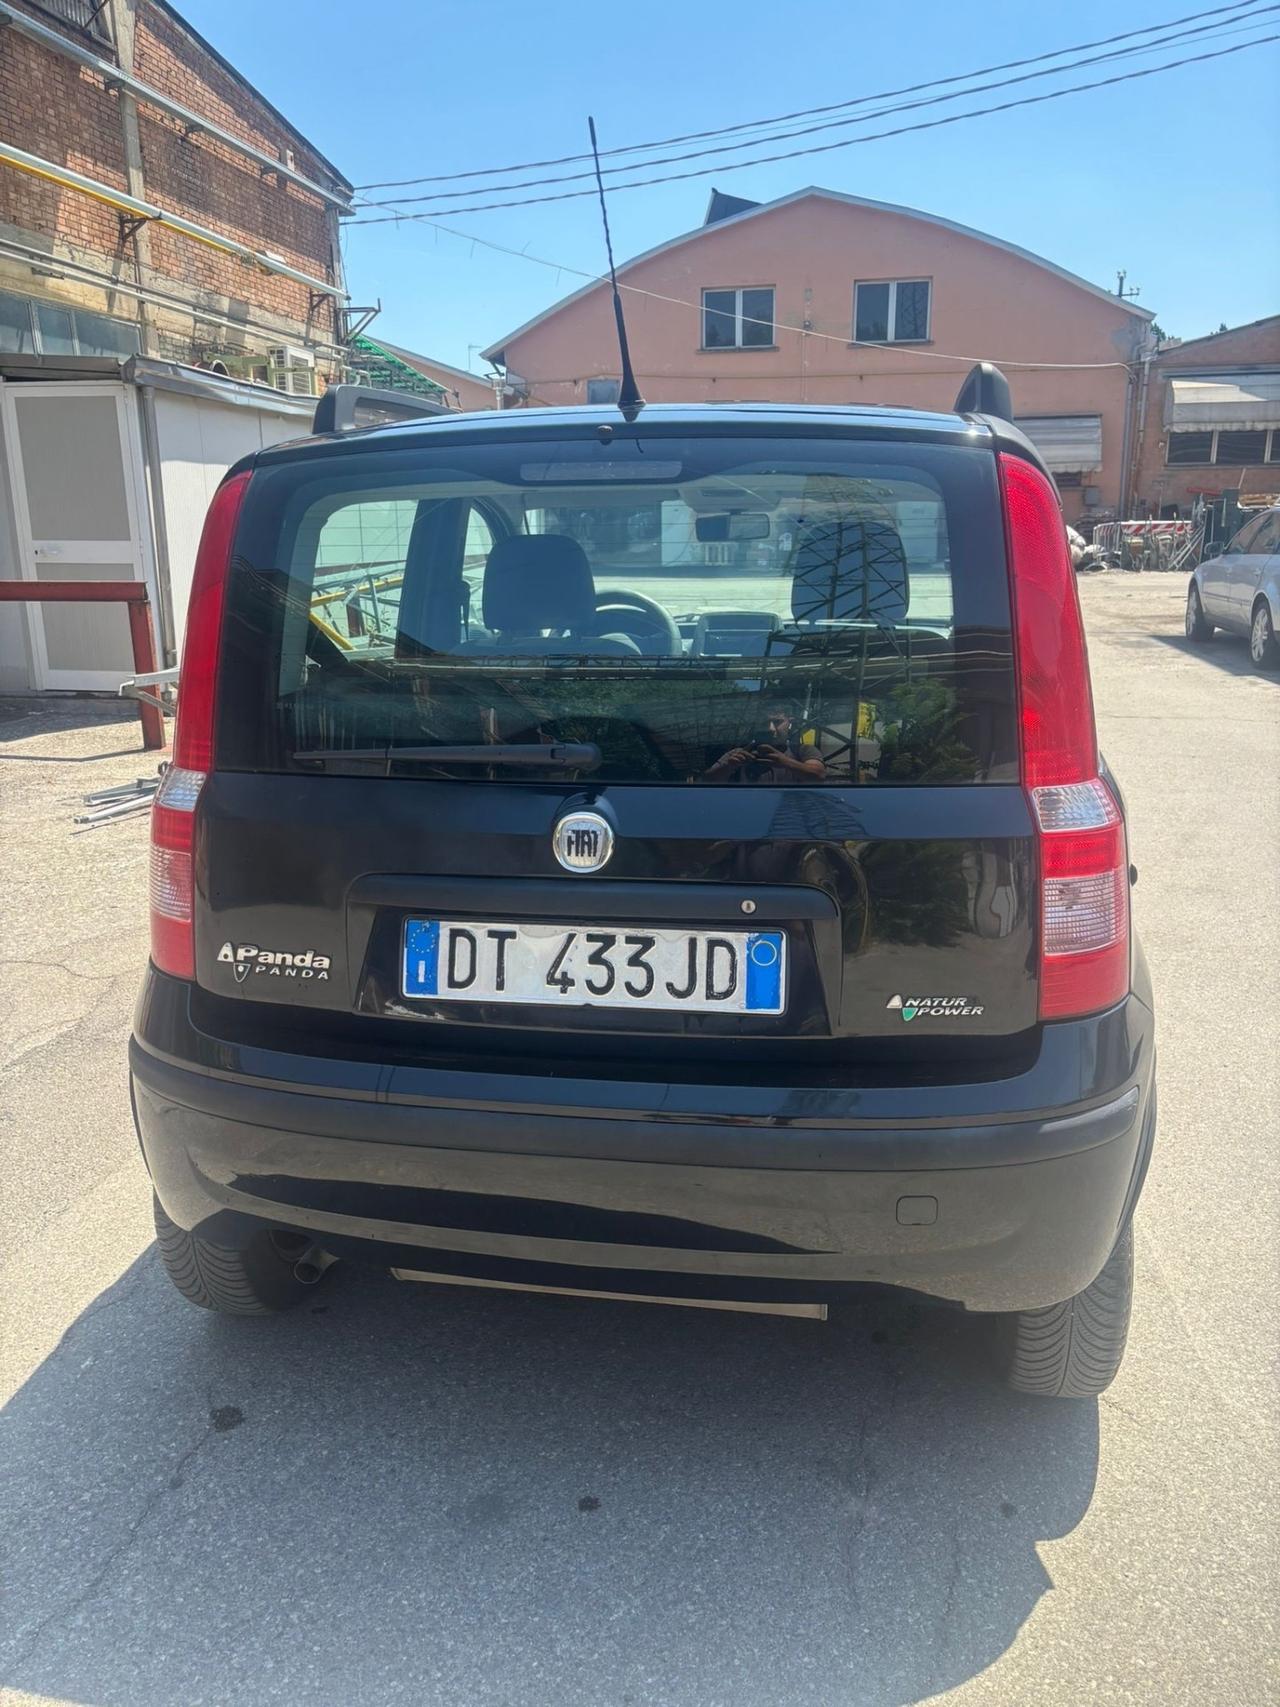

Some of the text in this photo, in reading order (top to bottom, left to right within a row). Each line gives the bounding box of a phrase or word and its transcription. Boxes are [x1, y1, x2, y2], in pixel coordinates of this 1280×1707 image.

[567, 829, 599, 857] FIAT
[236, 944, 331, 969] Panda
[447, 928, 518, 992] DT
[255, 965, 329, 980] PANDA
[905, 997, 968, 1007] NATUR
[917, 1006, 984, 1016] POWER
